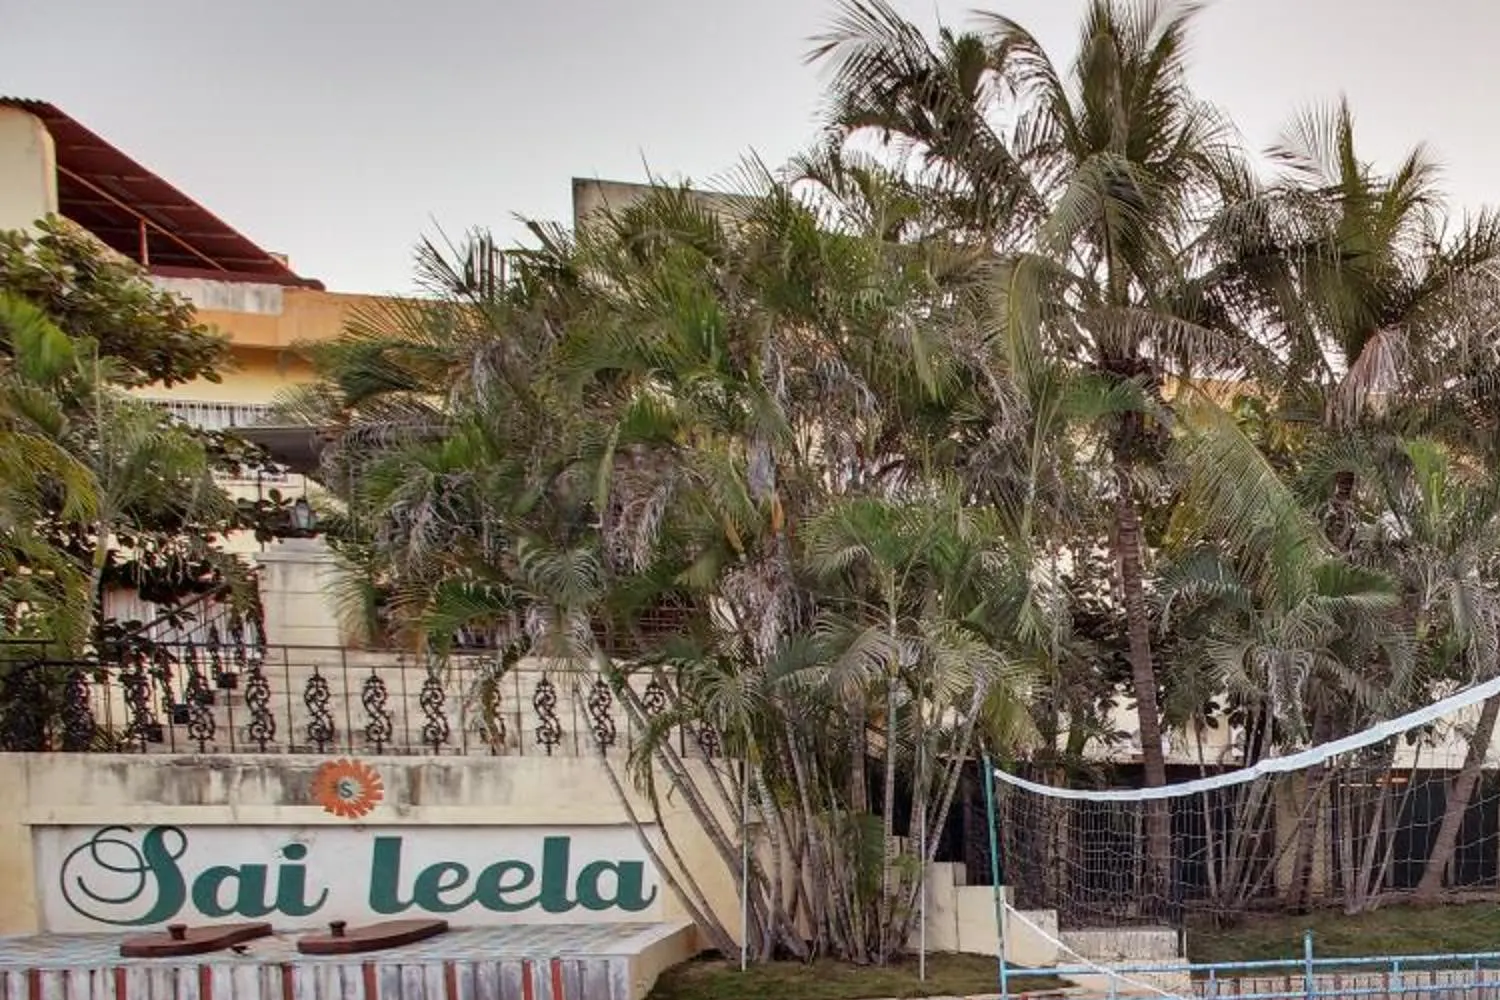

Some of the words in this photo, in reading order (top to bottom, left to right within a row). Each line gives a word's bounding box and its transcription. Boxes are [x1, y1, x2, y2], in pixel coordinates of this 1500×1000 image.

[340, 779, 353, 799] S
[60, 824, 329, 926] Sai
[367, 835, 657, 915] leela
